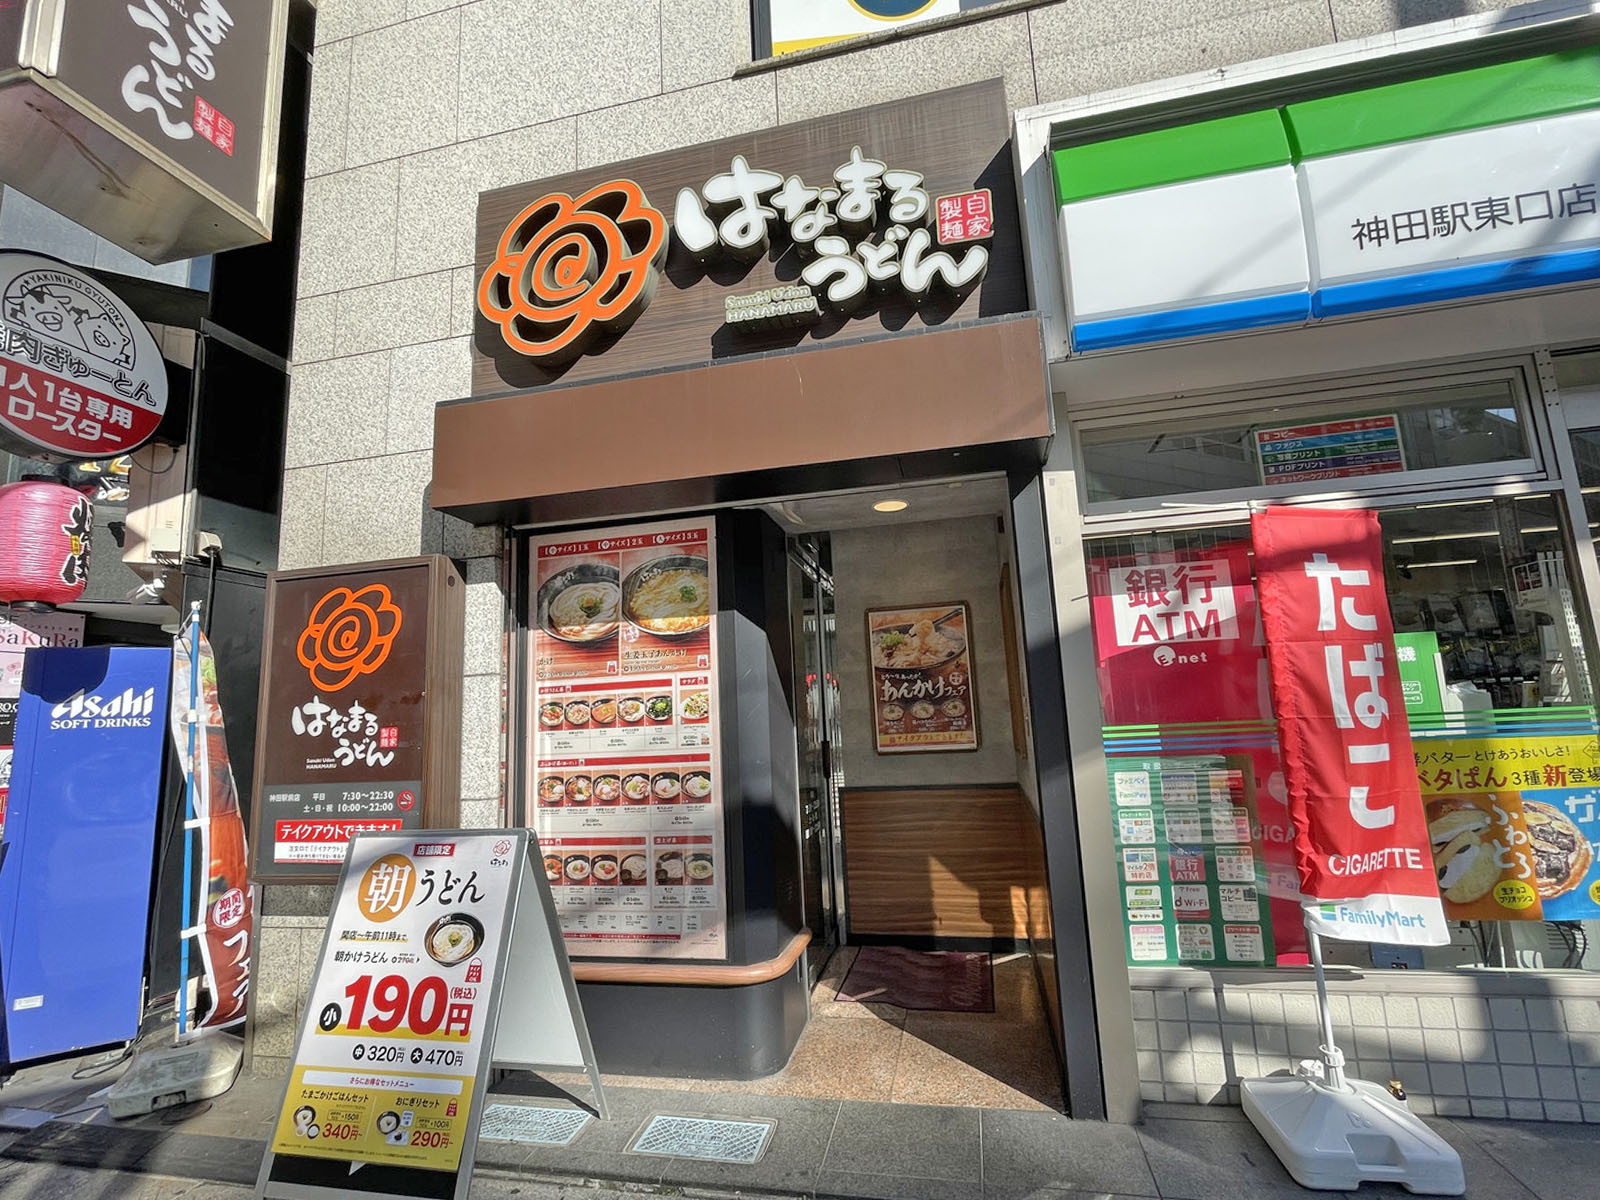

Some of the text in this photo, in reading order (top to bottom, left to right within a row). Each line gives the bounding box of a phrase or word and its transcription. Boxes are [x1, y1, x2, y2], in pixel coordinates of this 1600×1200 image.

[675, 145, 928, 251] はなまる
[1351, 182, 1597, 250] 神田駅東口店
[802, 225, 987, 301] うどん
[727, 297, 817, 321] HANAMARU
[0, 321, 156, 406] 肉ぎゅーとん
[8, 396, 122, 442] ロースター
[1125, 564, 1218, 608] 銀行
[1132, 609, 1222, 643] ATM
[51, 687, 154, 718] Asahi
[51, 717, 151, 730] SOFT DRINKS
[292, 695, 378, 738] はなまる
[333, 737, 395, 767] うどん
[1328, 848, 1424, 876] CIGARETTE
[364, 862, 486, 914] 朝 うどん
[1340, 907, 1426, 928] FamilyMart
